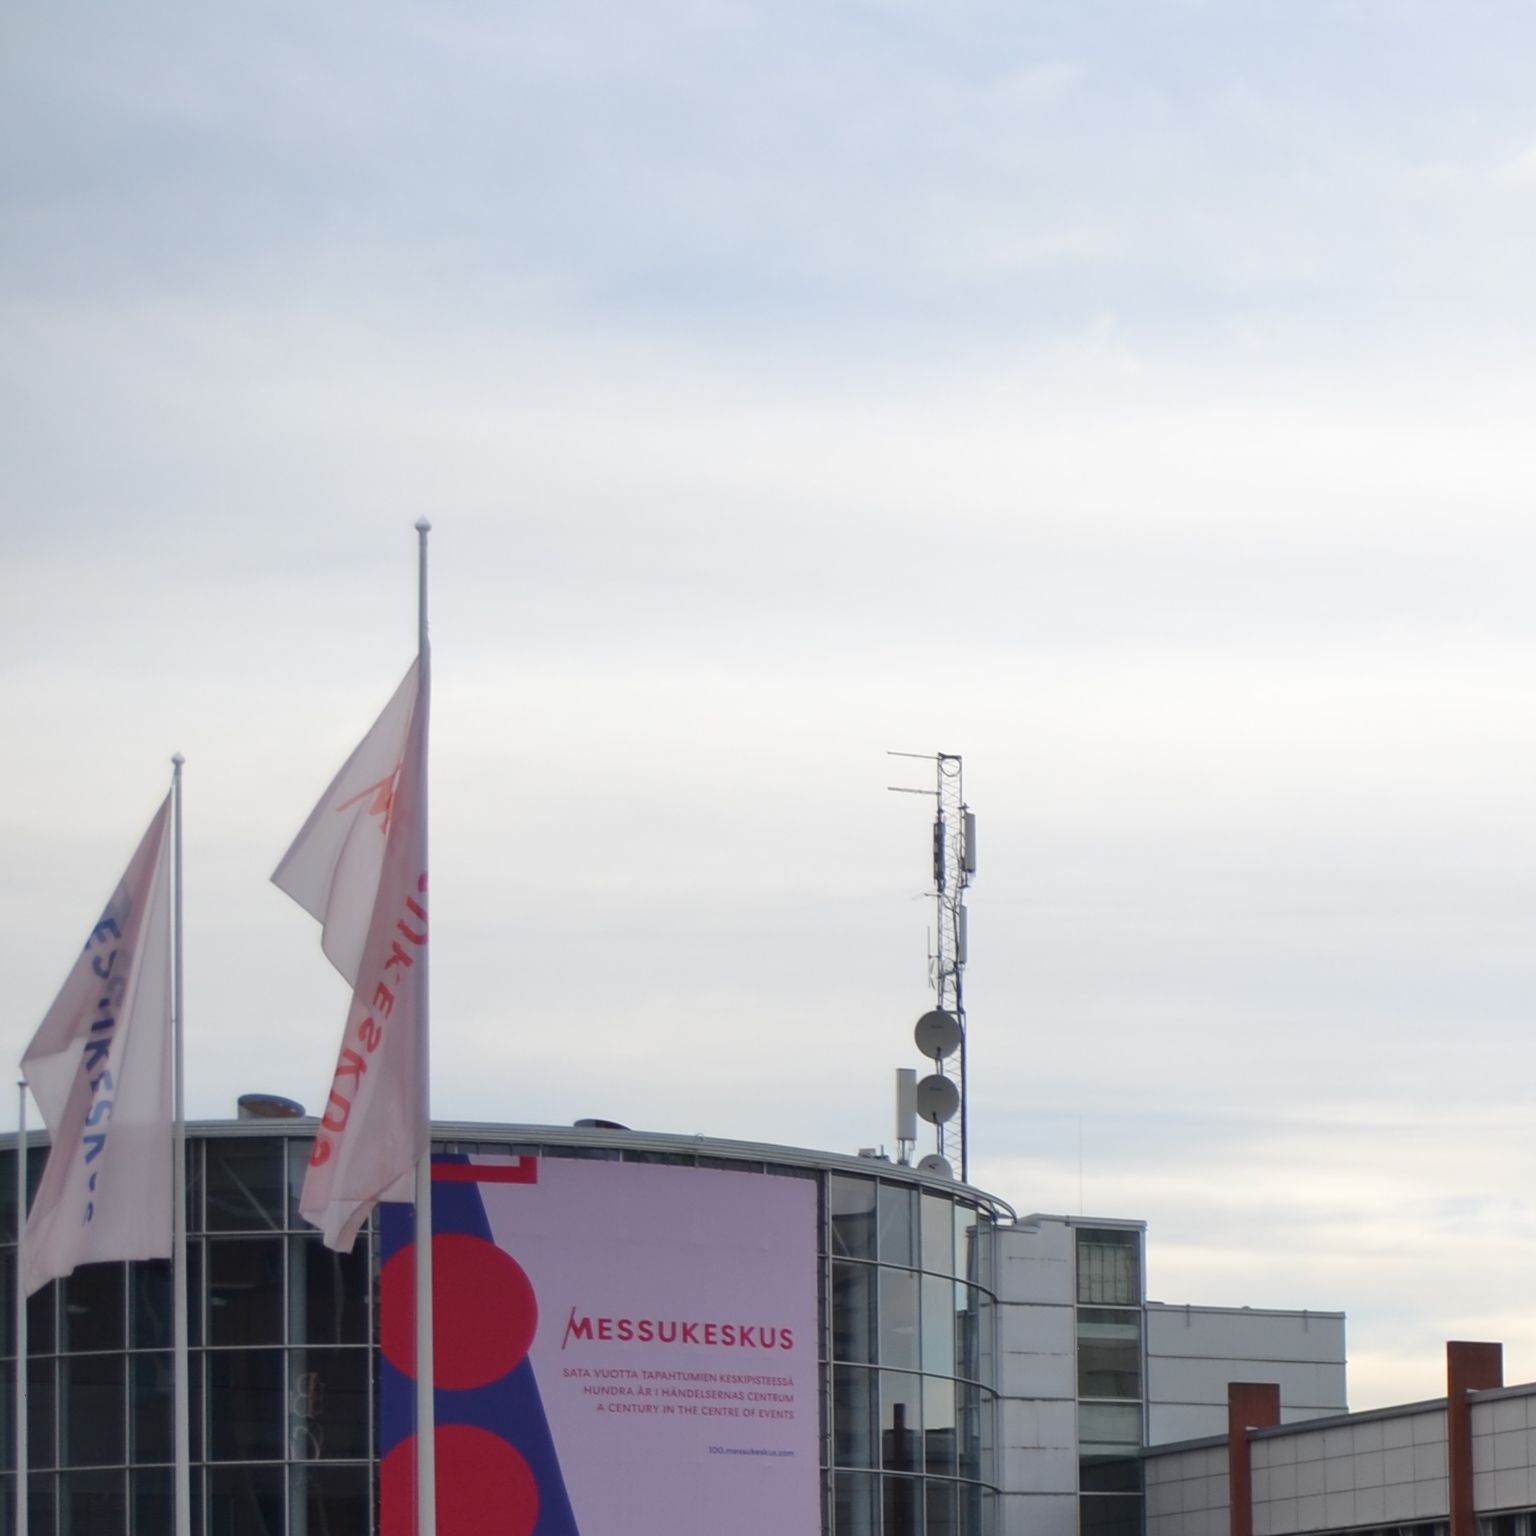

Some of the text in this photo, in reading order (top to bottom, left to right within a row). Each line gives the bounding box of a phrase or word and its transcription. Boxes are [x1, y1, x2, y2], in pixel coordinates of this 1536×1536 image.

[562, 1306, 794, 1350] MESSUKESKUS
[563, 1368, 591, 1379] SATA
[594, 1369, 638, 1380] VUOTTA
[643, 1370, 717, 1383] TAPAHTUMIEN
[584, 1386, 634, 1397] HUNDRA
[747, 1391, 794, 1403] CENTRUM
[596, 1403, 794, 1420] A CENTURY IN THE CENTRE OF EVENTS
